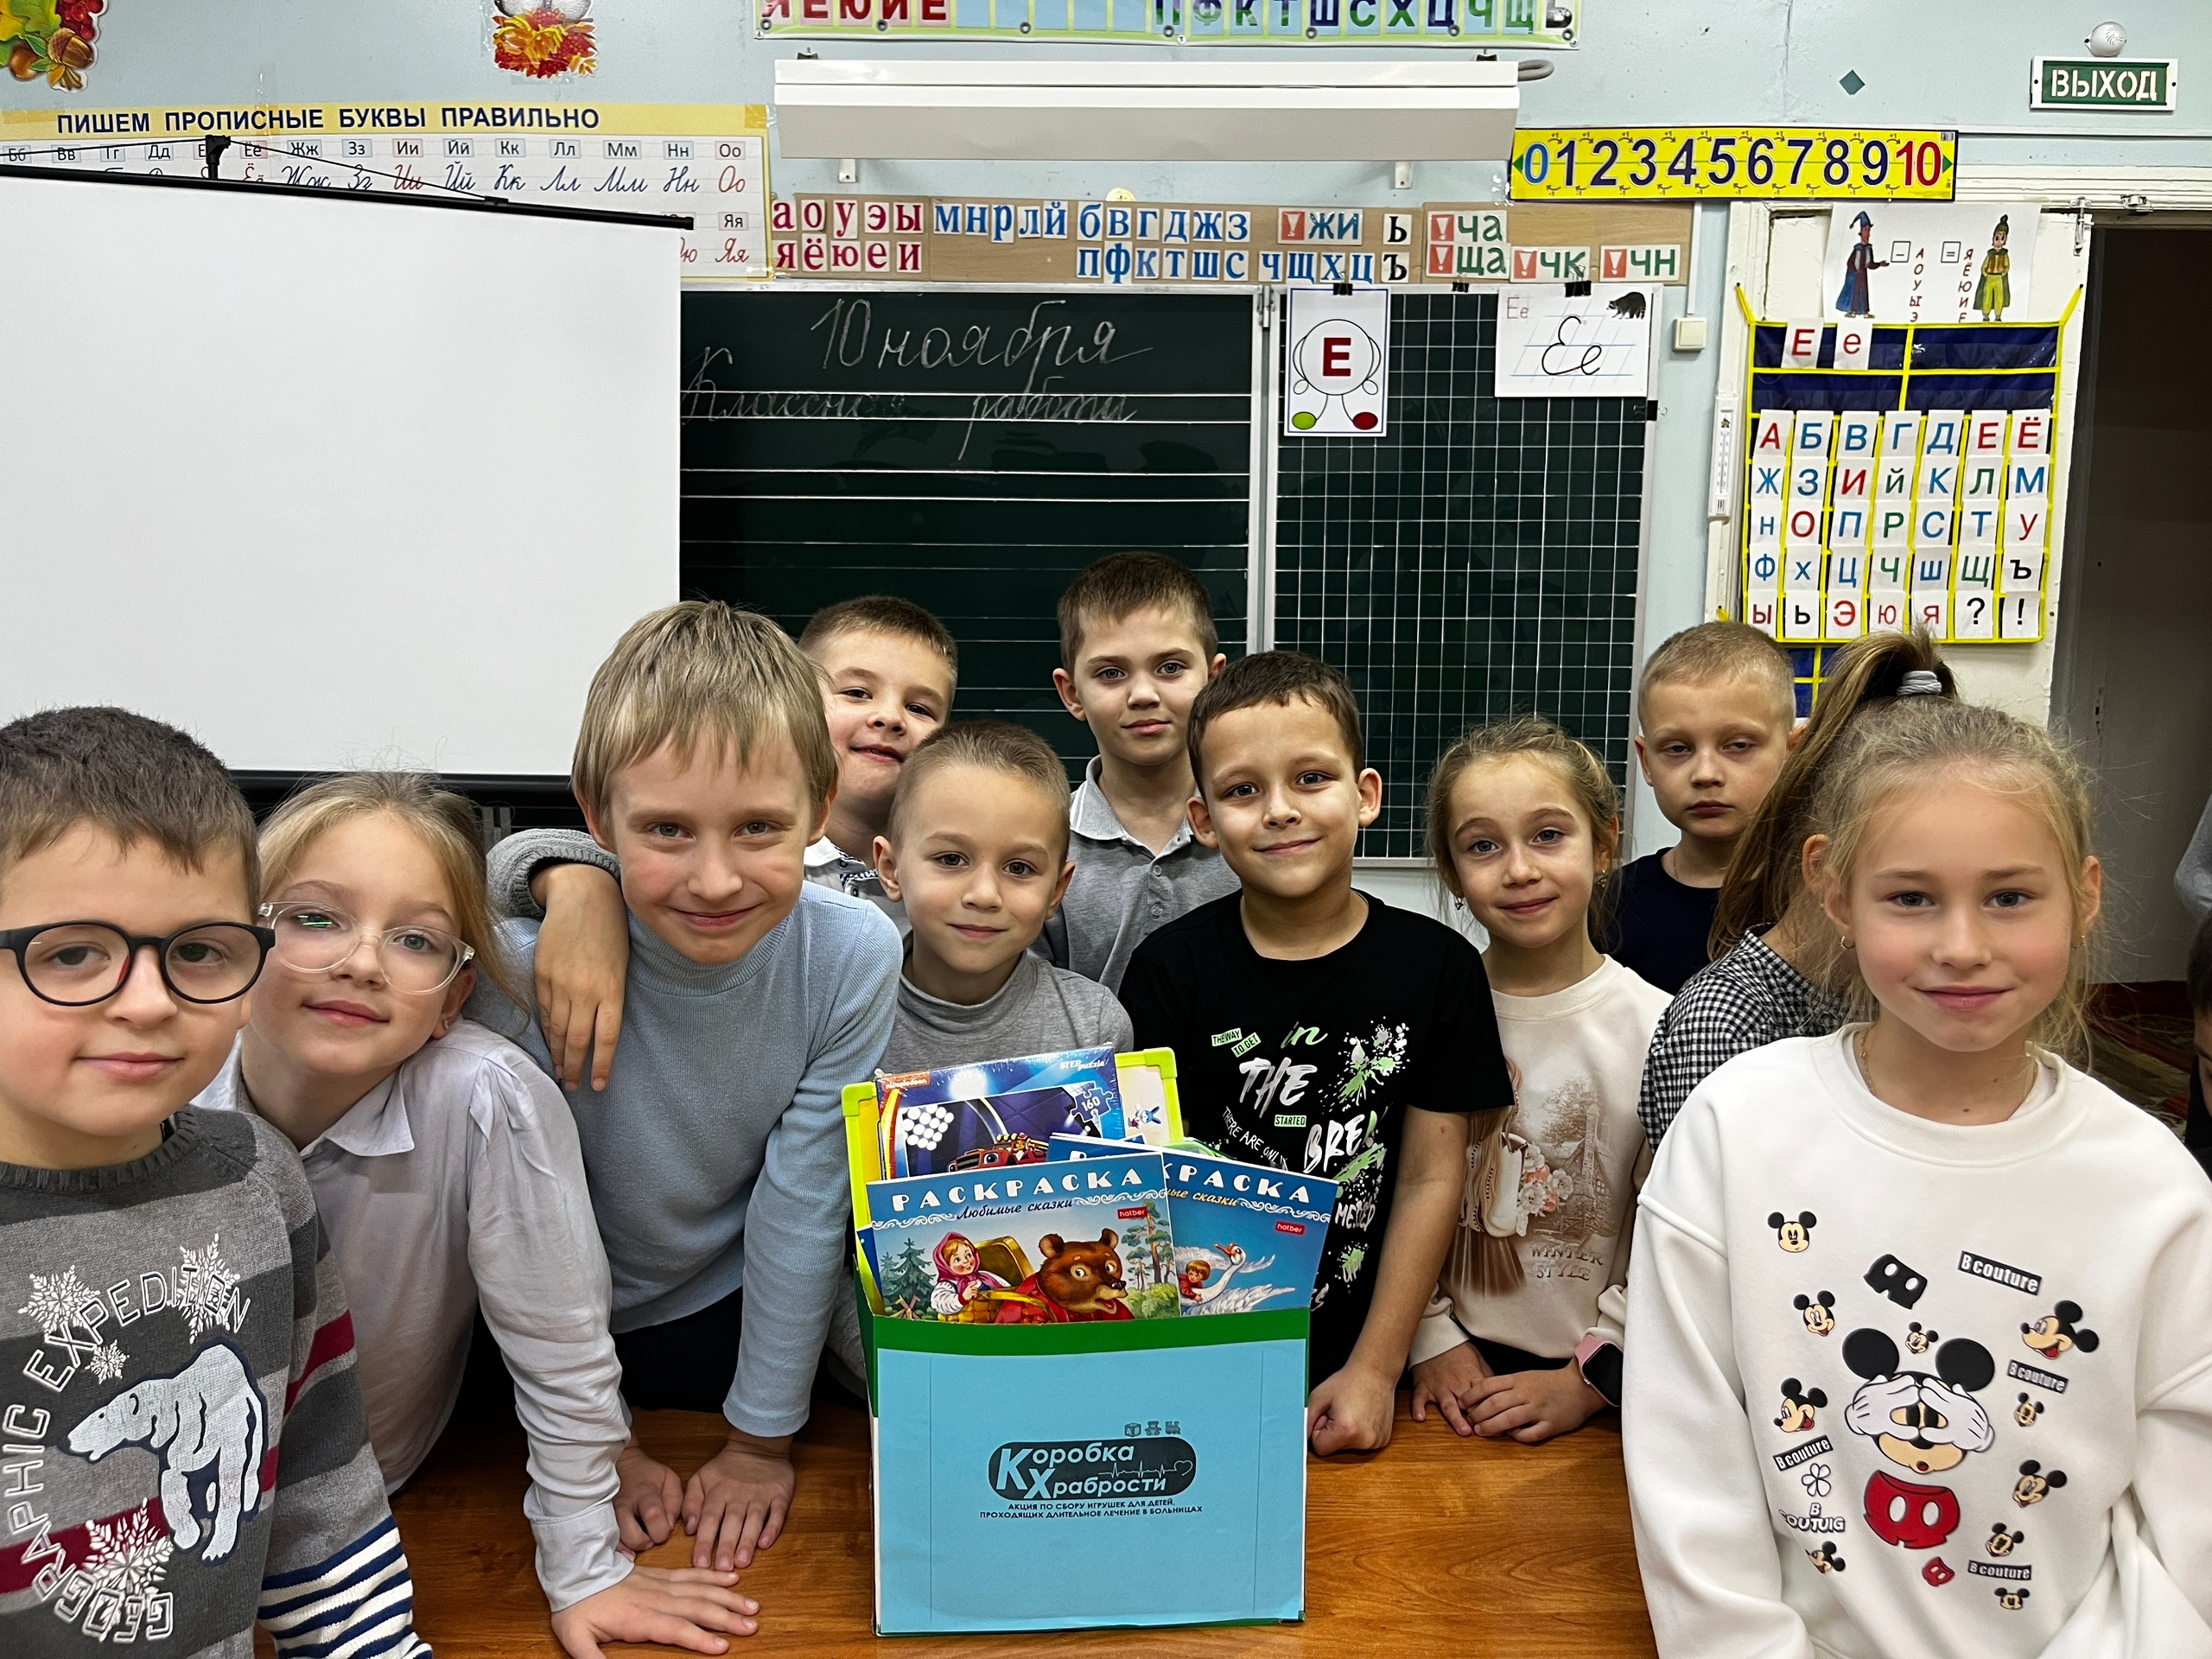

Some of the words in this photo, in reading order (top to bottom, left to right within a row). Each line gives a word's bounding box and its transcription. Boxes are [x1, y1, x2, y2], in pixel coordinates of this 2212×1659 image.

[2050, 69, 2158, 102] ВЫХОД
[56, 112, 150, 134] ПИШЕМ
[164, 109, 324, 132] ПРОПИСНЫЕ
[339, 107, 426, 129] БУКВЫ
[442, 107, 600, 129] ПРАВИЛЬНО
[105, 146, 121, 160] Гг
[148, 145, 171, 162] Дд
[290, 143, 319, 156] Жж
[347, 143, 365, 156] Зз
[396, 142, 420, 156] Ии
[447, 139, 470, 156] Йй
[500, 141, 520, 156] Кк
[553, 143, 576, 157] Лл
[607, 143, 638, 157] Мм
[667, 144, 690, 158] Нн
[719, 144, 741, 158] Оо
[1524, 142, 1549, 184] 0
[1556, 139, 1576, 187] 1
[1589, 138, 1619, 187] 2
[1629, 137, 1657, 187] 3
[1667, 137, 1697, 185] 4
[1707, 137, 1737, 185] 5
[1747, 137, 1775, 186] 6
[1786, 138, 1815, 185] 7
[1823, 138, 1850, 186] 8
[1862, 139, 1890, 187] 9
[1895, 139, 1942, 188] 10
[540, 165, 582, 193] Лл
[594, 165, 648, 194] Мм
[663, 166, 700, 194] Нн
[717, 164, 746, 194] Оо
[723, 214, 743, 229] Яя
[715, 237, 749, 264] Яя
[811, 299, 871, 370] 10
[878, 299, 1154, 412] ноября
[1541, 315, 1603, 376] Ее
[1791, 328, 1815, 356] Е
[1842, 333, 1861, 354] е
[1322, 337, 1352, 377] Е
[1758, 423, 1781, 449] А
[1800, 423, 1822, 448] Б
[1845, 424, 1867, 451] В
[1891, 423, 1913, 449] Г
[1926, 423, 1954, 454] Д
[1977, 422, 1999, 449] Е
[2017, 416, 2041, 448] Ё
[1755, 467, 1781, 494] Ж
[1797, 467, 1819, 496] З
[1841, 468, 1866, 495] И
[1929, 467, 1952, 493] К
[1969, 468, 1994, 494] Л
[2014, 467, 2044, 493] М
[1790, 511, 1815, 538] О
[1839, 512, 1862, 538] П
[1884, 512, 1904, 538] Р
[1922, 511, 1945, 538] С
[1971, 511, 1993, 537] Т
[1839, 557, 1857, 588] Ц
[1961, 556, 1991, 588] Щ
[1834, 601, 1856, 627] Э
[1059, 1059, 1082, 1070] STEP
[1238, 1057, 1318, 1118] THE
[1081, 1096, 1101, 1112] 160
[1274, 1116, 1306, 1126] STARTED
[1239, 1130, 1265, 1152] ARE
[892, 1168, 1142, 1211] РАСКРАСКА
[1192, 1192, 1238, 1207] сказки
[957, 1204, 1022, 1220] Любимые
[1027, 1198, 1075, 1211] сказки
[1119, 1207, 1146, 1218] hatber
[1276, 1221, 1304, 1234] hatber
[1530, 1243, 1604, 1266] WINTER
[1536, 1264, 1592, 1281] STYLE
[1972, 1257, 2040, 1294] couture
[22, 1265, 251, 1392] EXPEDITION
[996, 1442, 1135, 1491] Коробка
[1023, 1468, 1167, 1499] Храбрости
[980, 1510, 1044, 1519] ПРОХОДЯЩИХ
[1046, 1510, 1102, 1518] ДЛИТЕЛЬНОЕ
[1150, 1506, 1203, 1515] БОЛЬНИЦАХ
[1007, 1503, 1038, 1511] АКЦИЯ
